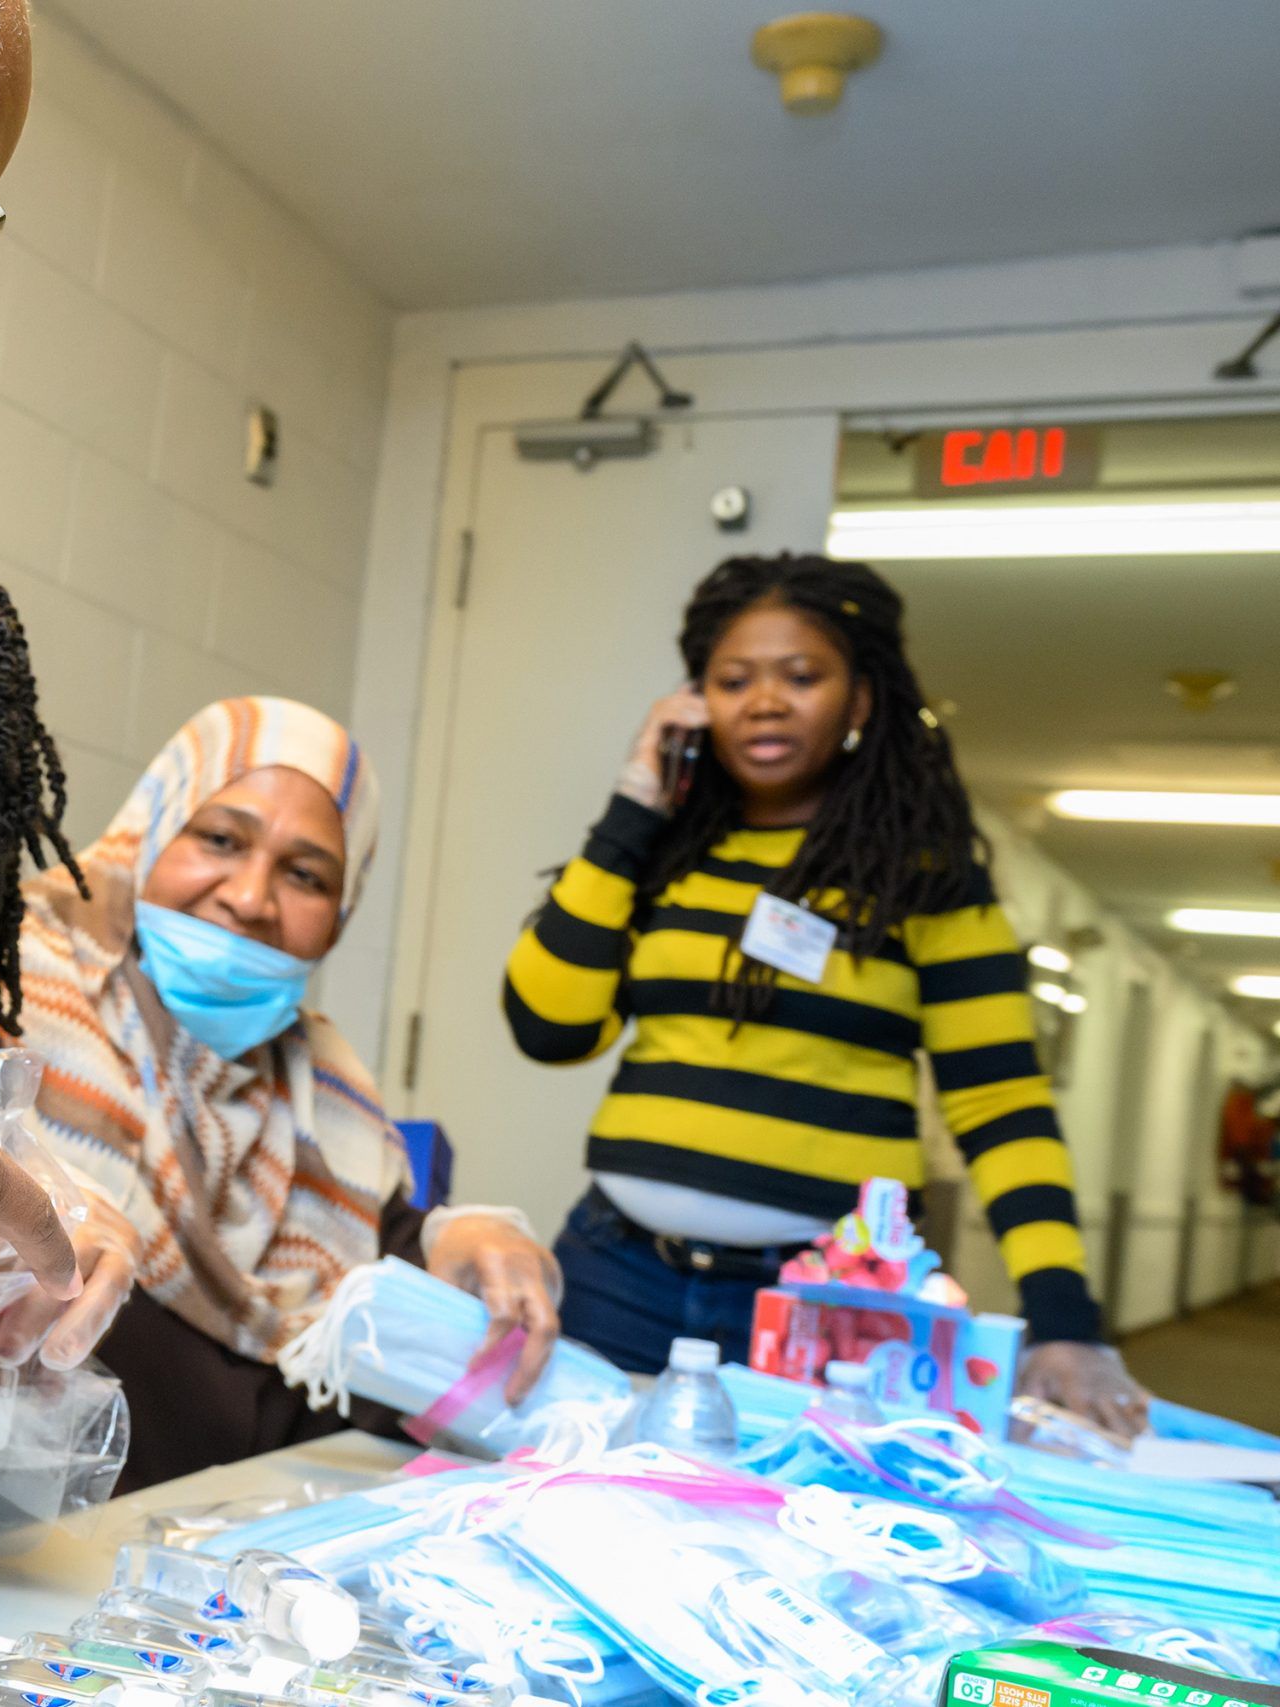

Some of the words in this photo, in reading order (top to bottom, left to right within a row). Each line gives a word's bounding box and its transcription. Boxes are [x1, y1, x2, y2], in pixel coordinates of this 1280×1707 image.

[961, 1682, 984, 1700] 50
[998, 1685, 1025, 1698] MOST
[1026, 1690, 1047, 1704] FITS
[999, 1694, 1021, 1706] SIZE
